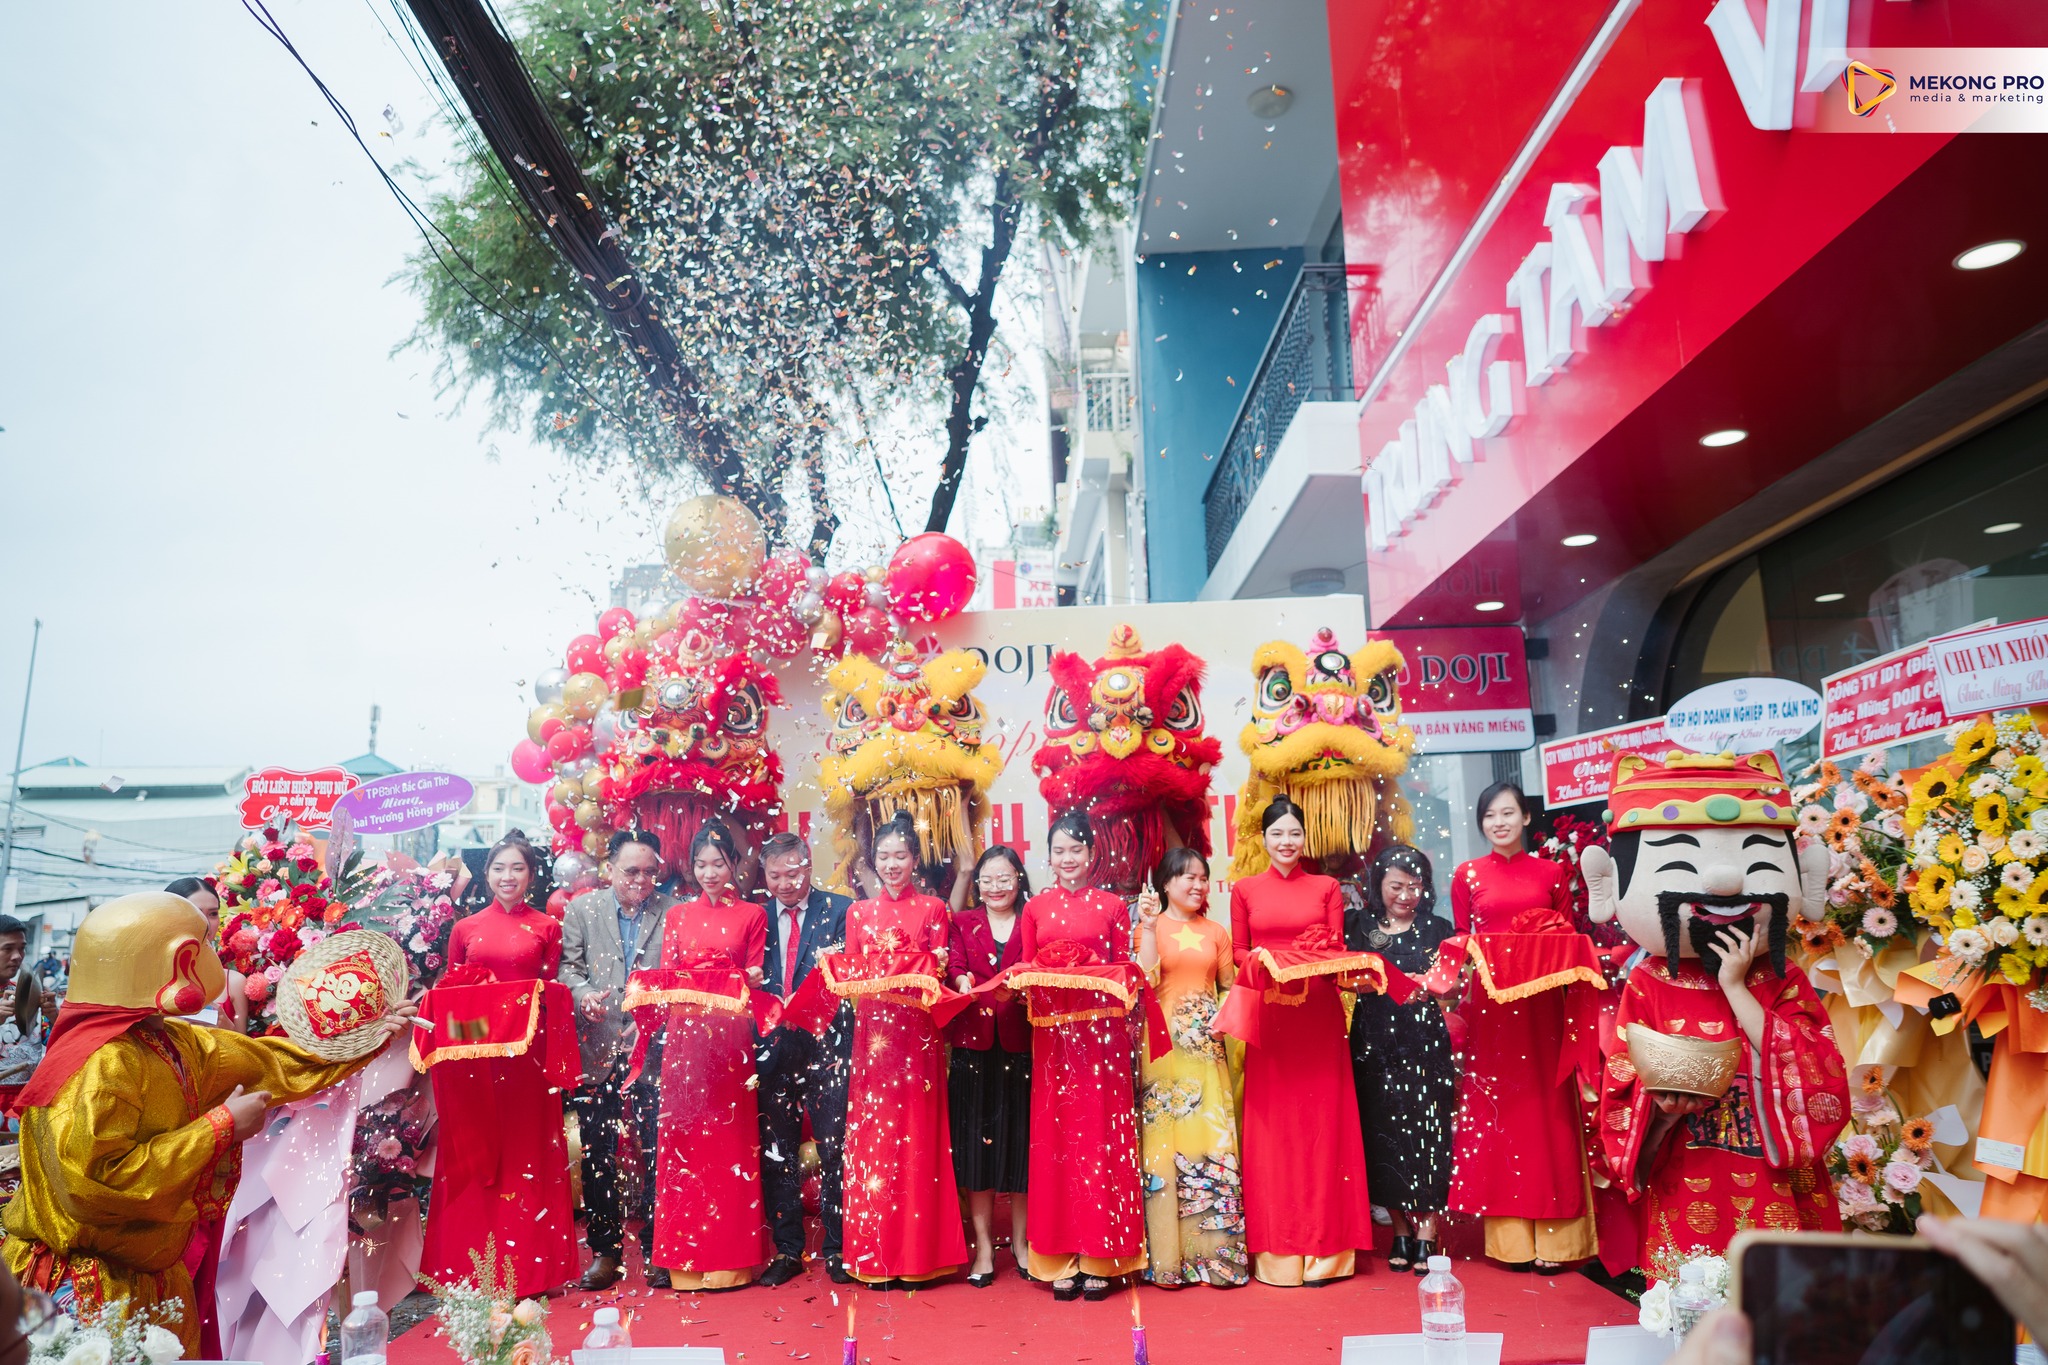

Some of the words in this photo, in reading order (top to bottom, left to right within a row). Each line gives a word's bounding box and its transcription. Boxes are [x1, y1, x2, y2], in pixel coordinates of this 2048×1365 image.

[1361, 313, 1513, 552] TRUNG
[1506, 77, 1709, 387] TÂM
[1418, 652, 1512, 696] DOJI
[1944, 648, 1976, 680] CHỊ
[1976, 642, 2004, 669] EM
[1827, 679, 1860, 703] CÔNG
[1861, 671, 1879, 691] TY
[1880, 662, 1904, 685] IDT
[1703, 707, 1731, 726] DOANH
[1733, 701, 1763, 725] NGHIỆP
[1768, 702, 1779, 719] TP.
[1826, 708, 1855, 729] Chúc
[1892, 684, 1921, 709] DOJI
[1426, 720, 1450, 735] BÁN
[1453, 719, 1484, 734] VÀNG
[1488, 716, 1526, 733] MIẾNG
[1737, 727, 1763, 739] Khai
[1829, 729, 1859, 752] Khai
[251, 776, 269, 796] HỘI
[269, 776, 291, 794] LIÊN
[366, 783, 401, 799] TPBank
[401, 780, 416, 793] Bắc
[417, 778, 432, 790] Cần
[434, 775, 450, 787] Thơ
[353, 816, 368, 829] hai
[406, 806, 433, 819] Hồng
[436, 800, 460, 813] Phát
